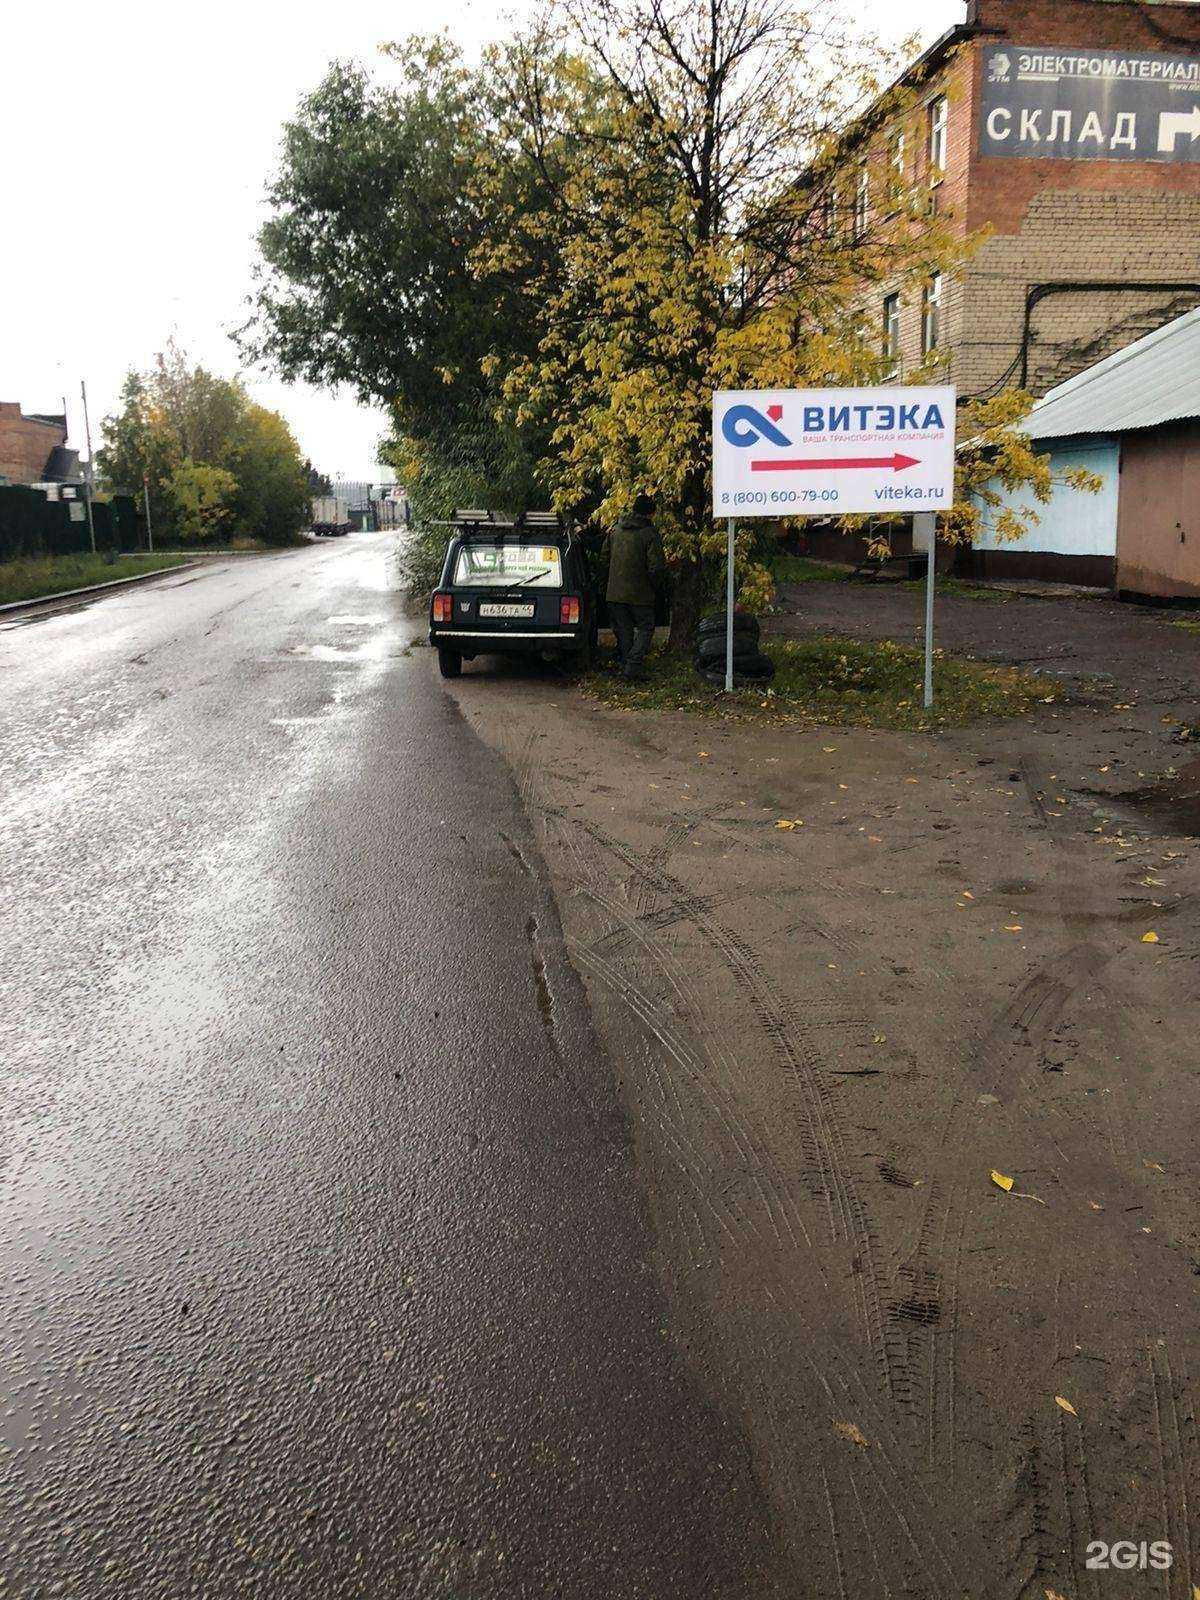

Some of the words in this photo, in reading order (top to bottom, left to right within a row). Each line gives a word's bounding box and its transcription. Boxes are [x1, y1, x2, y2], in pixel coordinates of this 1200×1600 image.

[1018, 54, 1200, 80] ЭЛЕКТРОМАТЕРИАЛ
[986, 107, 1137, 151] СКЛАД
[803, 404, 945, 432] ВИТЭКА
[802, 435, 828, 444] ВАША
[829, 433, 895, 443] ТРАНСПОРТНАЯ
[897, 431, 945, 442] КОМПАНИЯ
[721, 492, 730, 504] 8
[733, 490, 767, 505] (800)
[770, 488, 839, 503] 600-79-00
[874, 484, 945, 500] viteka.ru
